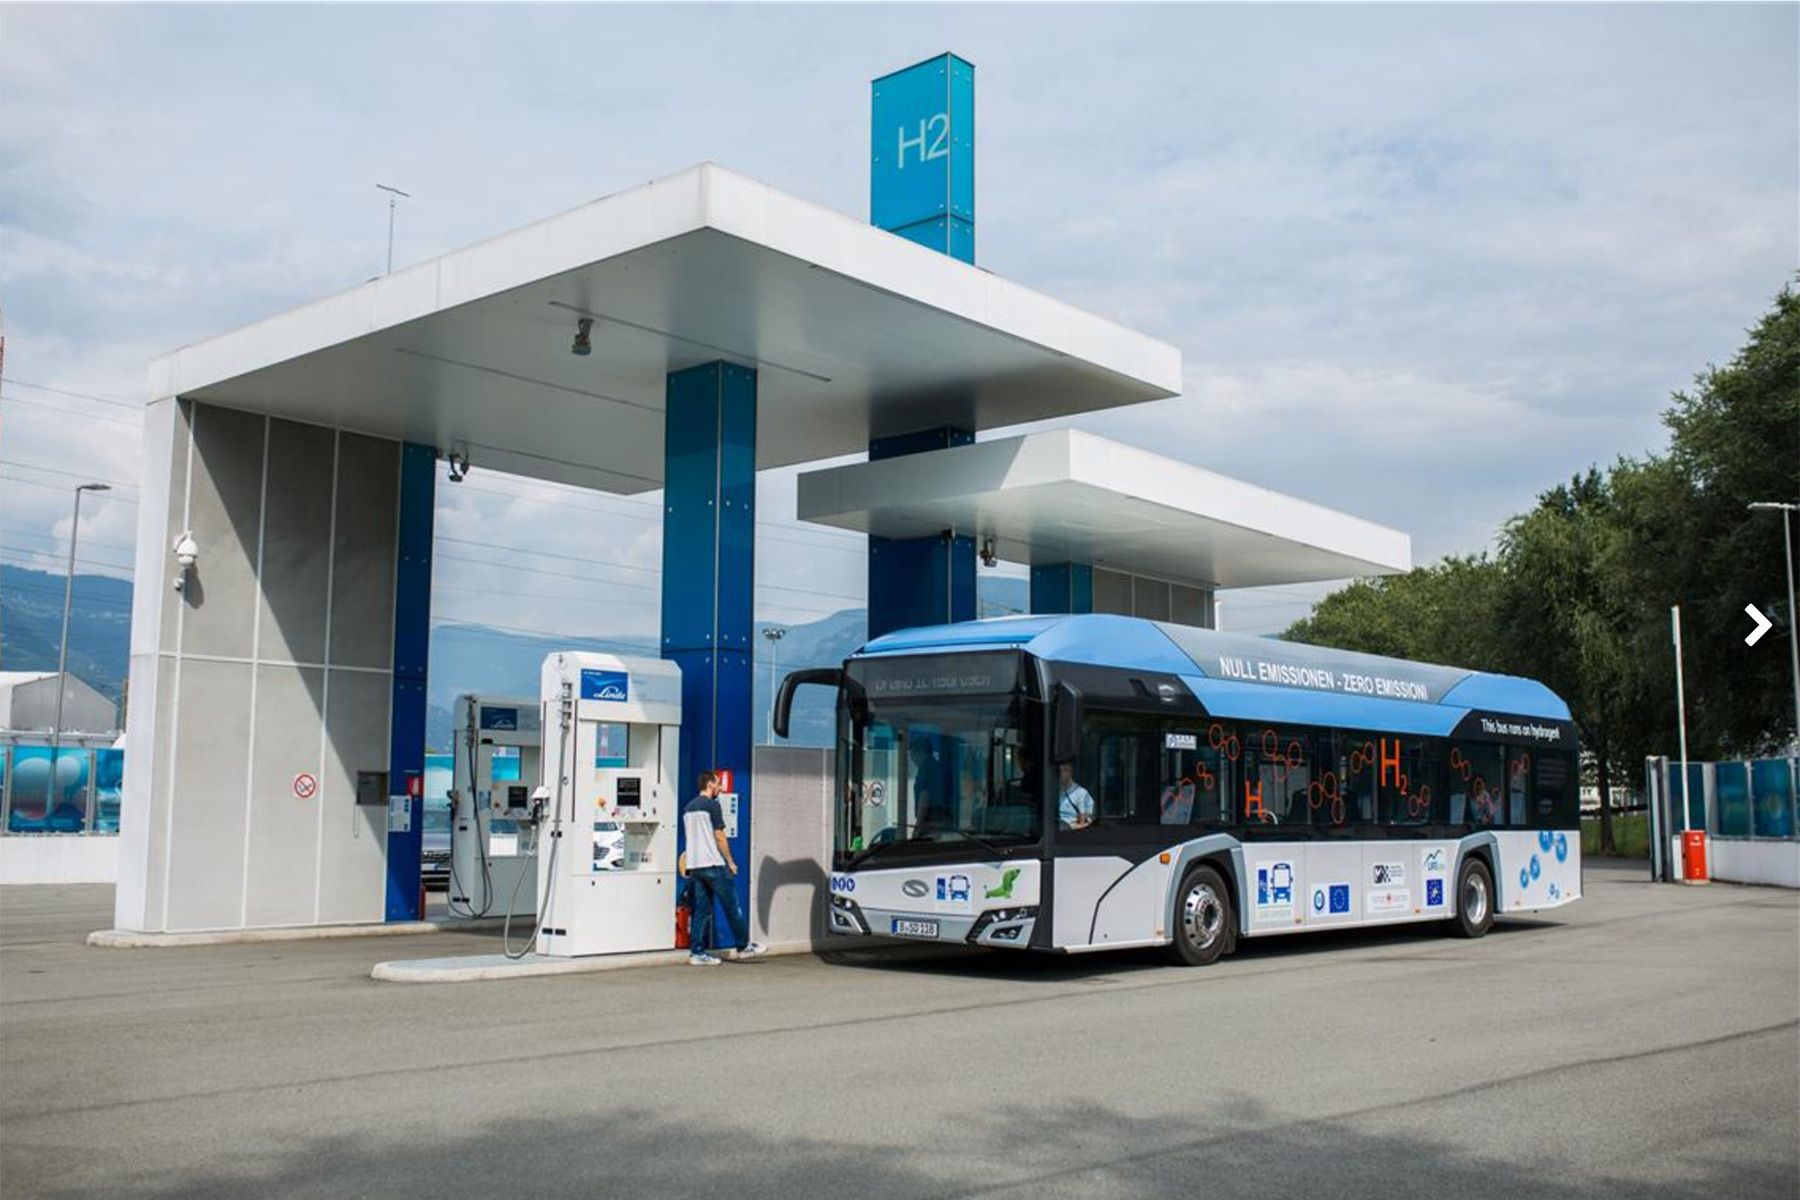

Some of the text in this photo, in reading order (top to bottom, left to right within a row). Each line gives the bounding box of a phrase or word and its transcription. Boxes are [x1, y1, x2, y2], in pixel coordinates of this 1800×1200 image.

[898, 113, 950, 170] H2
[593, 685, 627, 699] Linde
[1219, 656, 1257, 679] NULL
[1258, 661, 1335, 689] EMISSIONEN
[1342, 673, 1373, 693] ZERO
[1376, 677, 1429, 701] EMISSIONI
[1481, 718, 1496, 733] This
[1496, 720, 1508, 735] bus
[1508, 724, 1522, 736] runs
[1522, 726, 1532, 736] on
[1245, 779, 1263, 819] H
